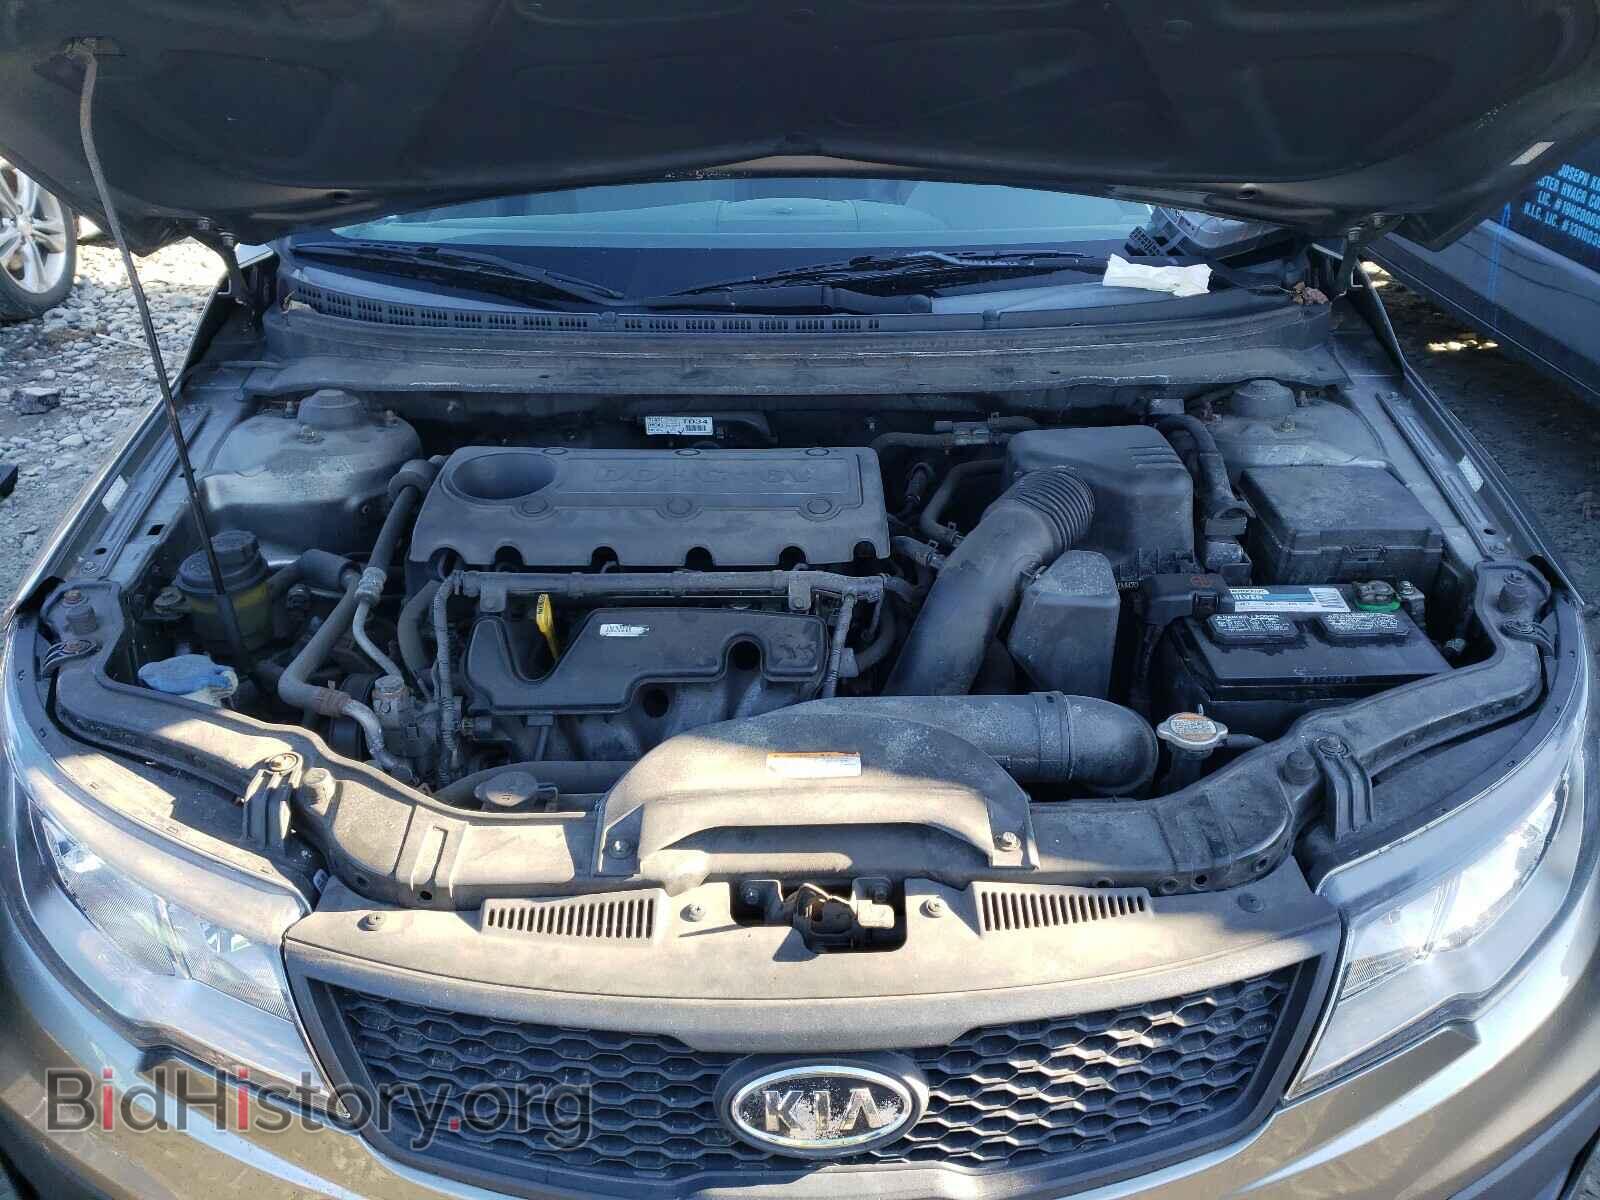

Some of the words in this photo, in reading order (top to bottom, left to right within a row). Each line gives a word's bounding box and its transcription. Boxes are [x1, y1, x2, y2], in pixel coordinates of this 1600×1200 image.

[1558, 164, 1590, 185] JOSEPH
[1561, 182, 1588, 203] HVACR
[762, 1087, 882, 1138] KIA
